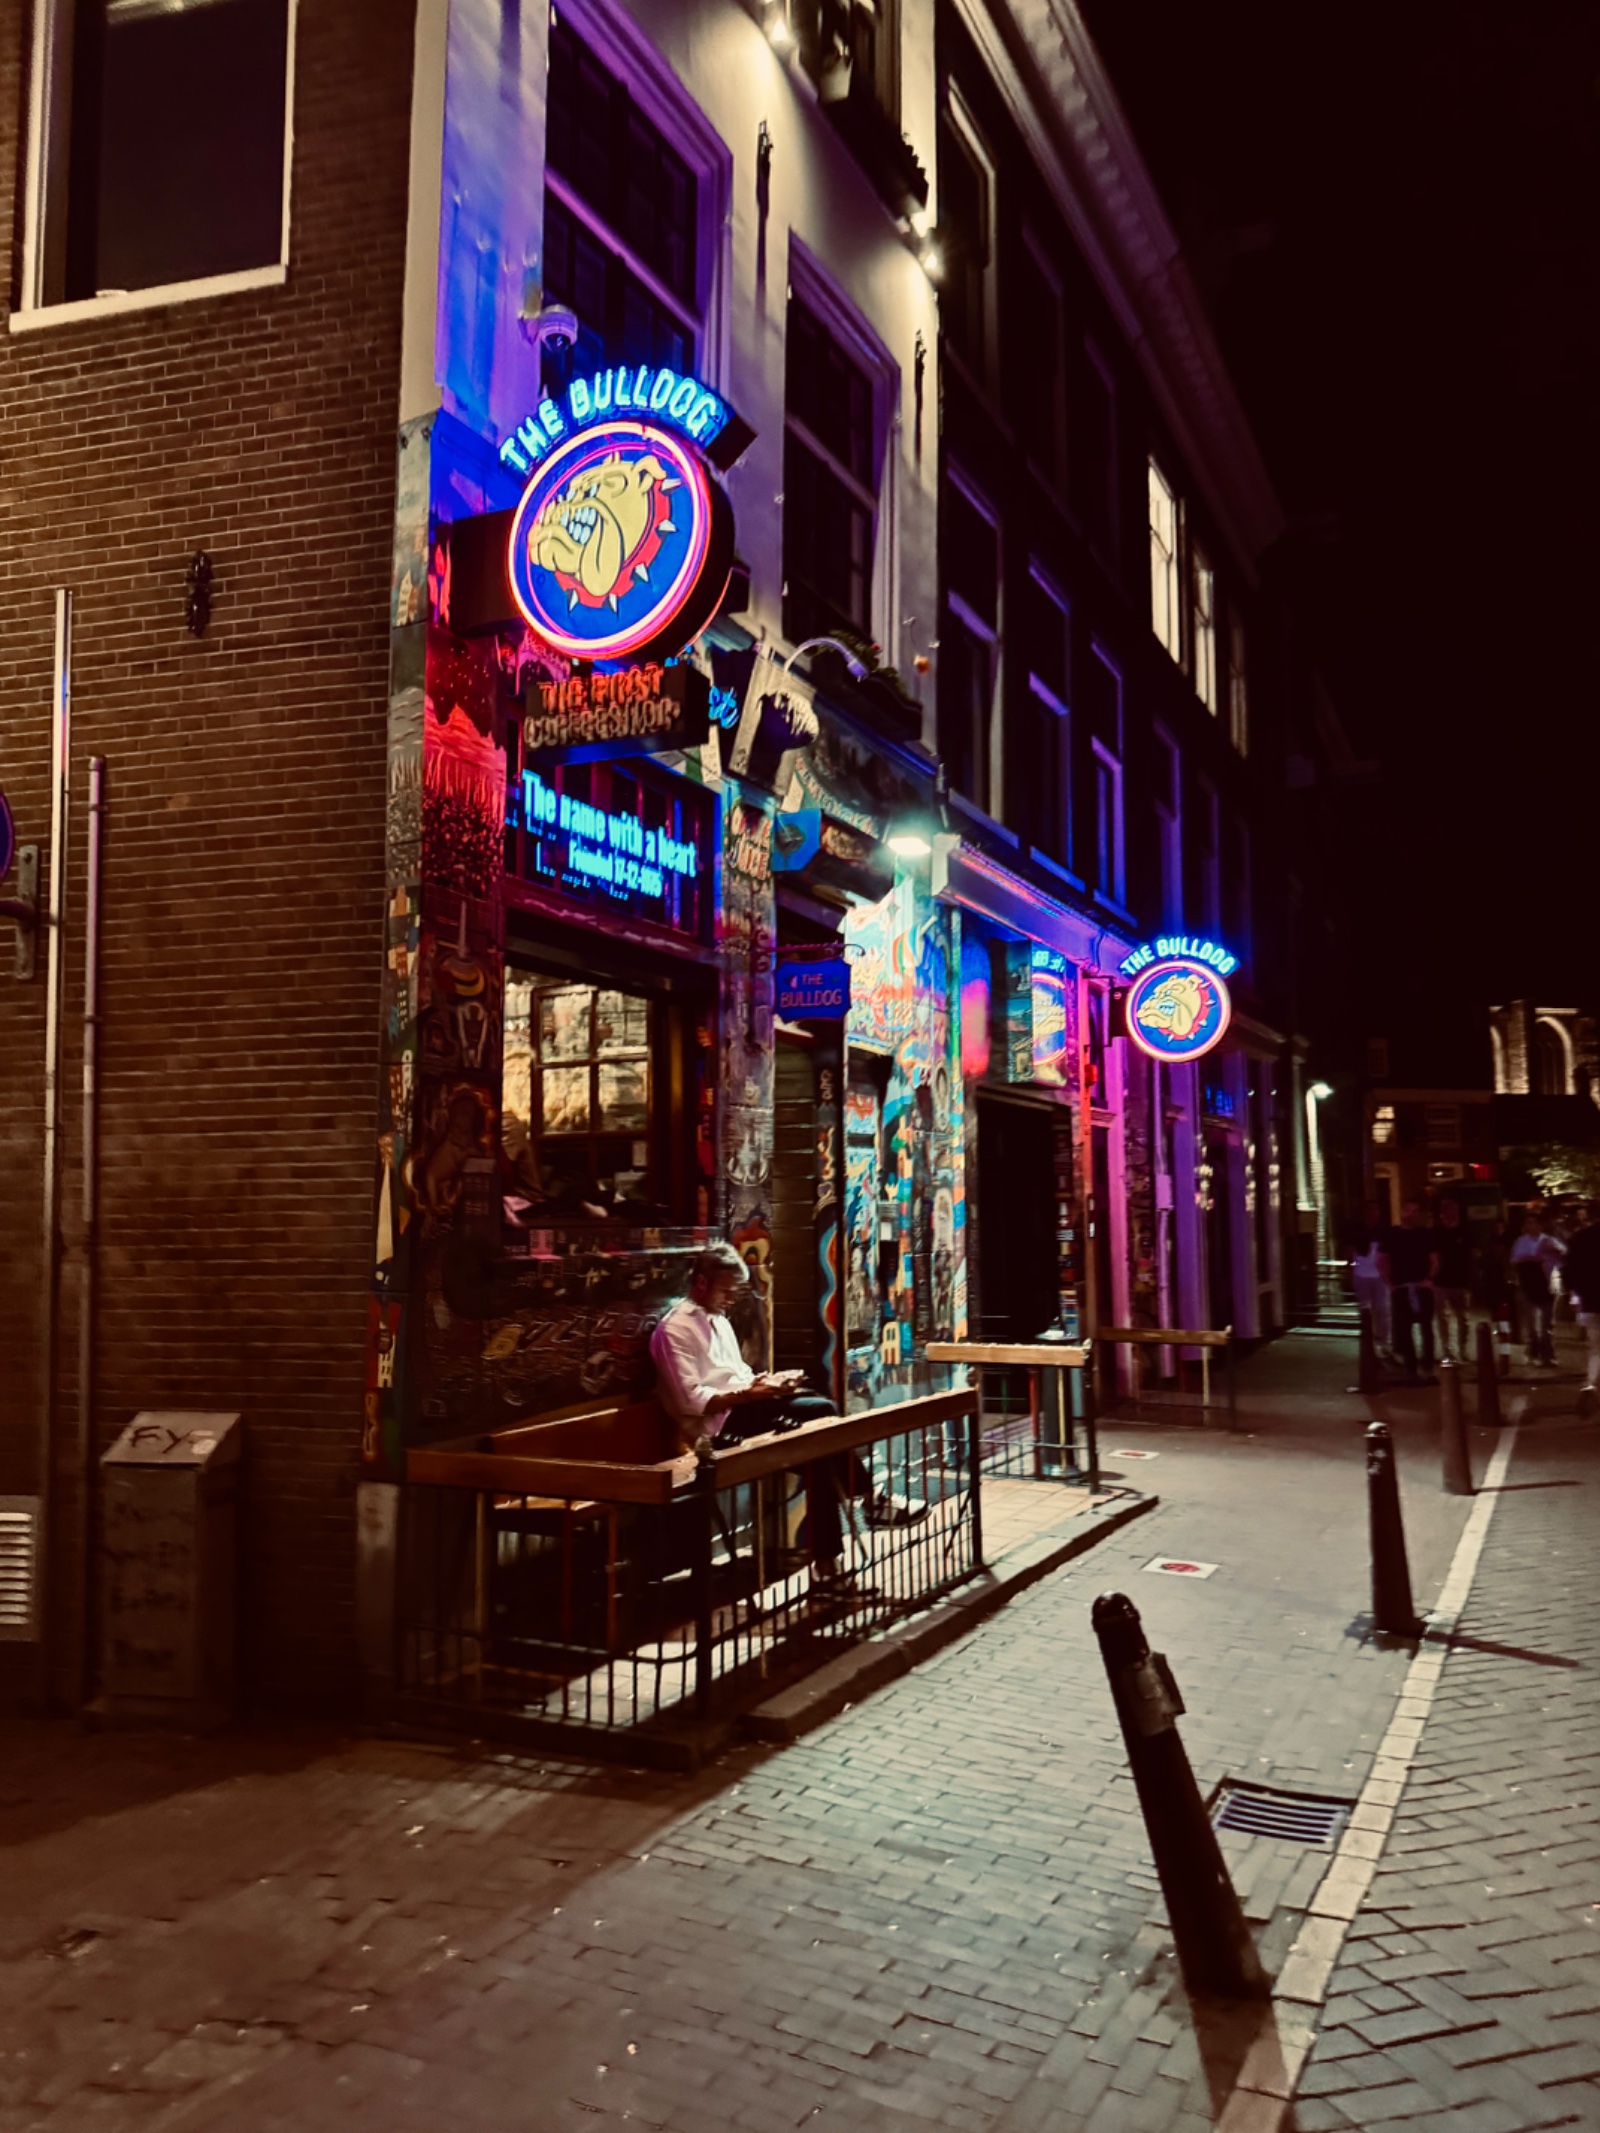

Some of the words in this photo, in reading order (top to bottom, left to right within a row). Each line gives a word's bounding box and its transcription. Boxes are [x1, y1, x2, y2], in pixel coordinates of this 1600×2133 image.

[500, 398, 564, 470] THE
[569, 364, 717, 439] BULLDOG
[591, 661, 664, 704] FIRST
[522, 768, 557, 824] The
[560, 794, 606, 843] name
[608, 811, 644, 858] with
[645, 830, 656, 862] a
[658, 826, 697, 878] heart
[1120, 944, 1156, 975] THE
[780, 988, 843, 1008] BULLDOG
[802, 973, 824, 986] THE
